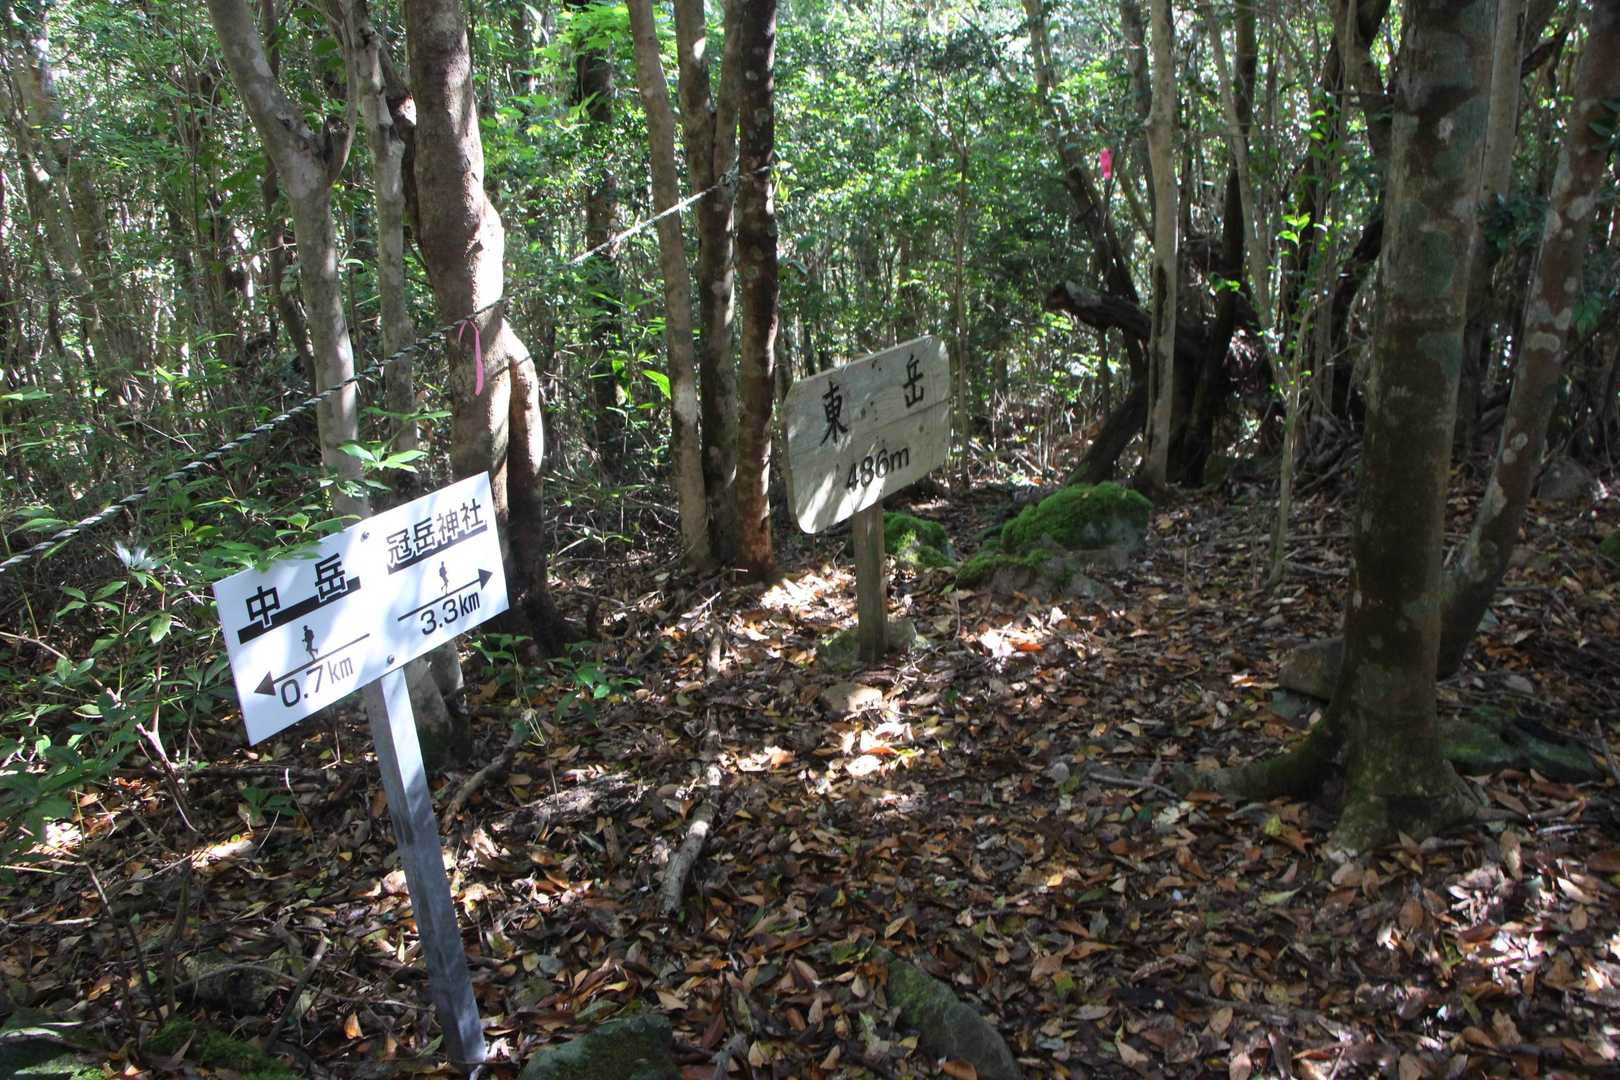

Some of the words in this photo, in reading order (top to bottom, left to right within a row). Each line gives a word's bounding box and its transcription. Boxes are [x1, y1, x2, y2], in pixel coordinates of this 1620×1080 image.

[819, 353, 924, 446] 東岳
[846, 447, 910, 490] 486m
[386, 498, 484, 562] 冠岳神社
[245, 553, 346, 625] 中岳
[420, 592, 480, 636] 3.3km
[280, 656, 354, 708] 0.7km
